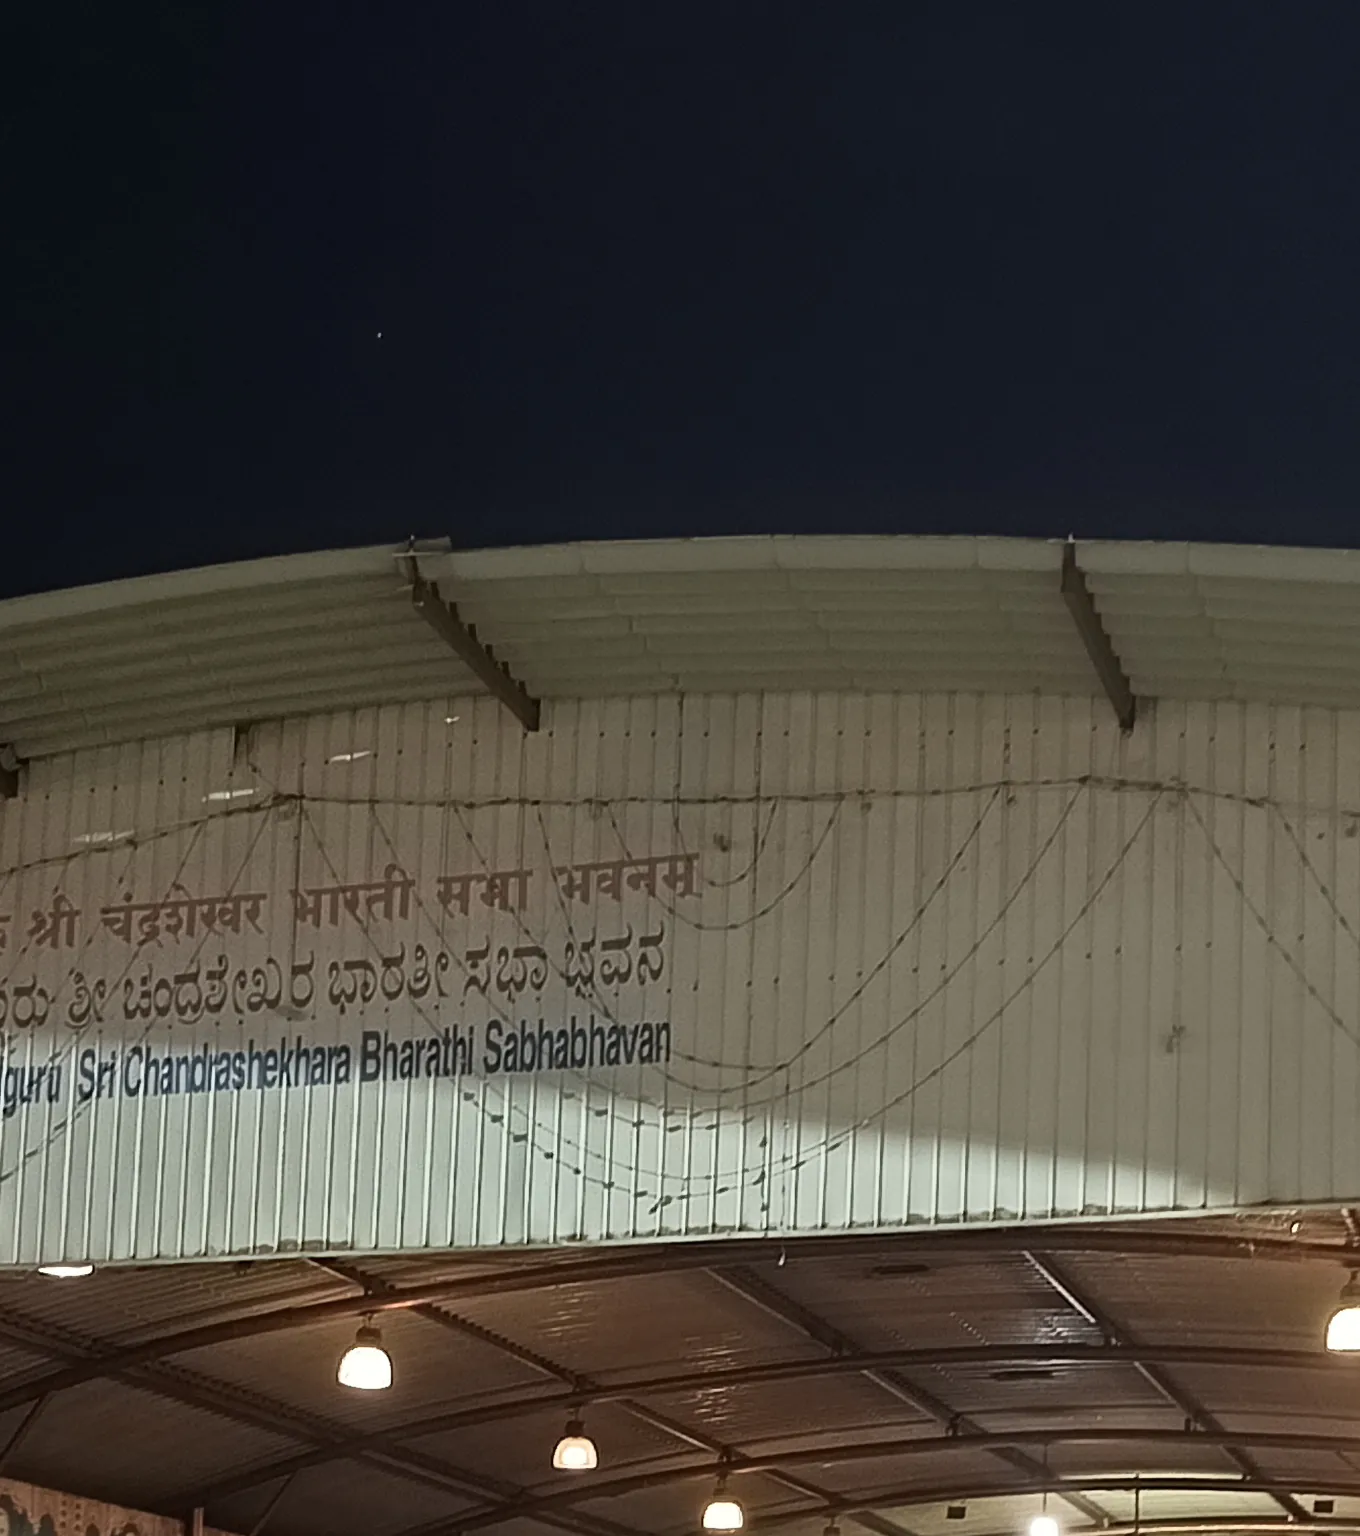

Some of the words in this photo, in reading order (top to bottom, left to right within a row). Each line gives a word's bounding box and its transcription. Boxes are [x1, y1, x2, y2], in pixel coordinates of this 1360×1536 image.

[27, 892, 81, 950] श्री
[288, 863, 416, 929] भारती
[436, 868, 534, 918] सभा
[64, 969, 107, 1030] ಶ್ರೀ
[328, 940, 449, 1015] ಭಾರತೀ
[463, 934, 549, 1003] ಸಭಾ
[77, 1048, 117, 1101] Sri
[124, 1034, 351, 1098] Chandrashekhara
[360, 1023, 475, 1083] Bharathi
[483, 1014, 672, 1074] Sabhabhavan
